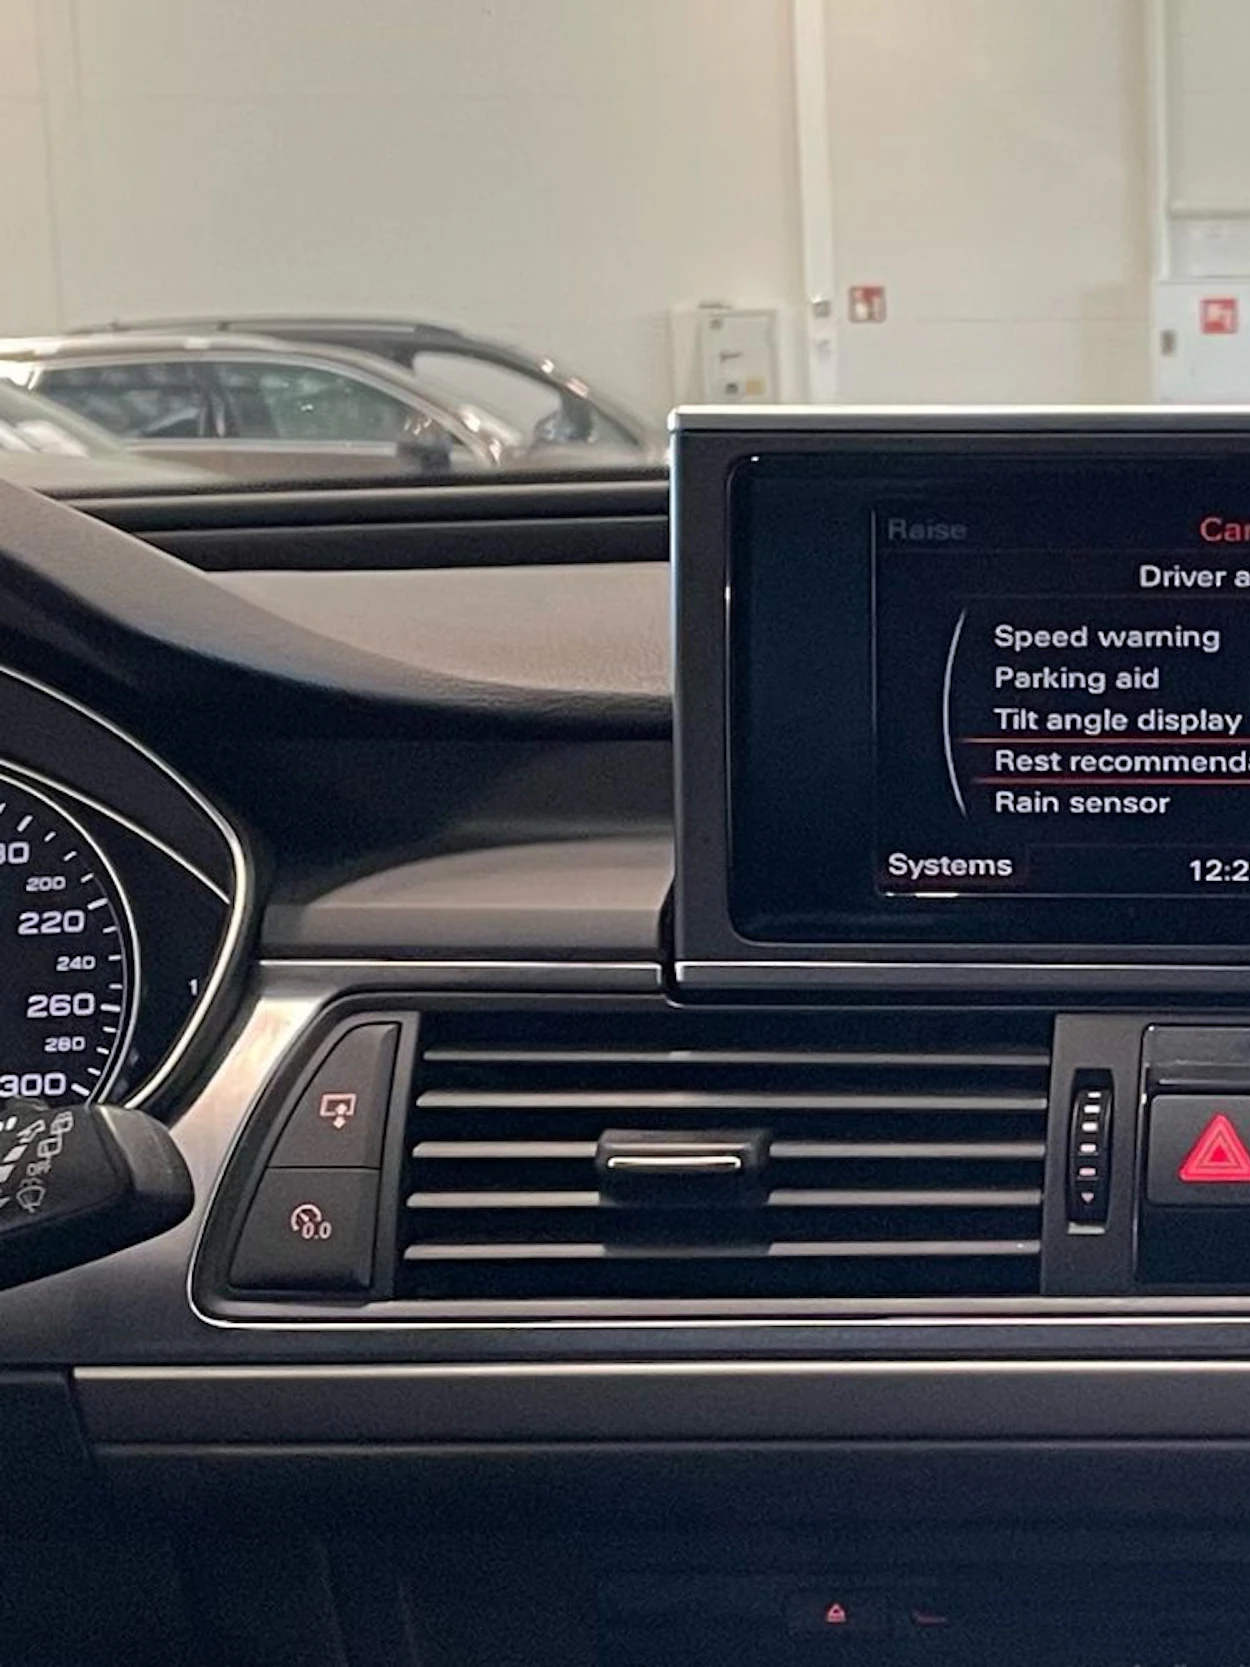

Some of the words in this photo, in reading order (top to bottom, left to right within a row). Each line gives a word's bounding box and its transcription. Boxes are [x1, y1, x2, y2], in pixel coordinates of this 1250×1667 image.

[888, 518, 968, 541] Raise
[1139, 564, 1227, 588] Driver
[994, 624, 1088, 652] Speed
[1097, 625, 1220, 653] warning
[994, 666, 1106, 695] Parking
[1115, 666, 1160, 689] aid
[993, 707, 1039, 730] Tilt
[1046, 708, 1129, 736] angle
[1137, 708, 1243, 736] display
[995, 749, 1062, 772] Rest
[995, 790, 1060, 813] Rain
[1069, 796, 1171, 814] sensor
[0, 841, 30, 865] 0
[888, 852, 1013, 880] Systems
[25, 875, 66, 892] 200
[17, 909, 86, 935] 220
[56, 955, 96, 972] 240
[26, 992, 96, 1018] 260
[44, 1036, 86, 1052] 280
[0, 1072, 67, 1097] 300
[301, 1221, 332, 1240] 0.0
